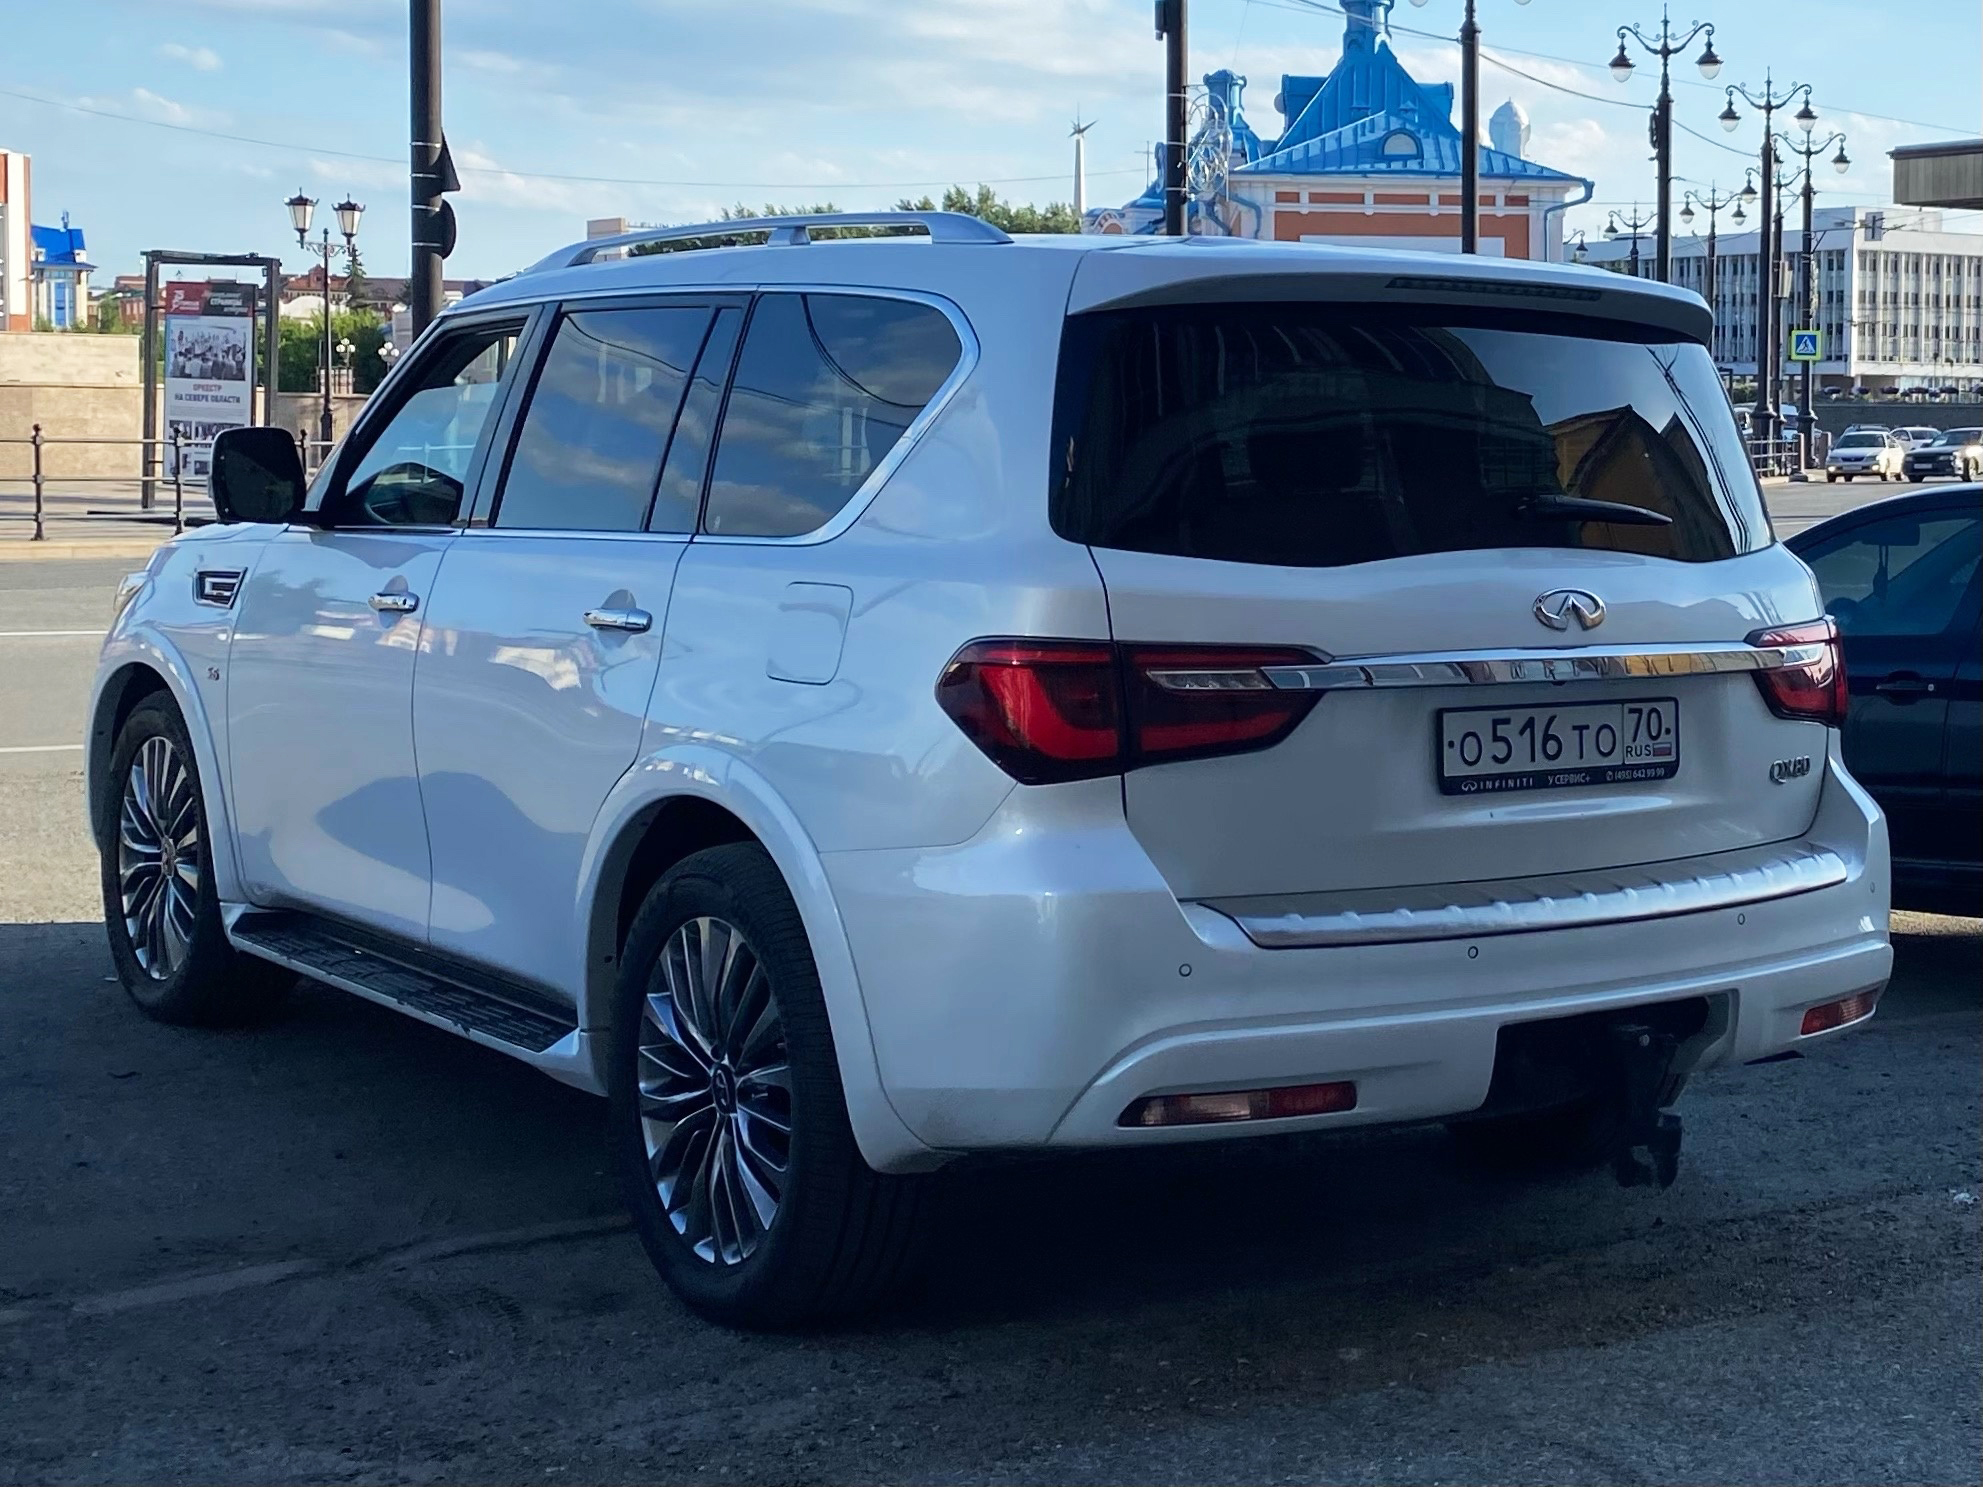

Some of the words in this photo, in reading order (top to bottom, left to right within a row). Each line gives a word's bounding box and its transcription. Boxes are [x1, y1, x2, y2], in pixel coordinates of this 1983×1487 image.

[185, 393, 209, 402] СЕВЕРЕ
[210, 395, 241, 404] ОБЛАСТИ
[1627, 706, 1664, 743] 70
[1625, 744, 1652, 758] RUS
[1480, 777, 1534, 790] INFINITI
